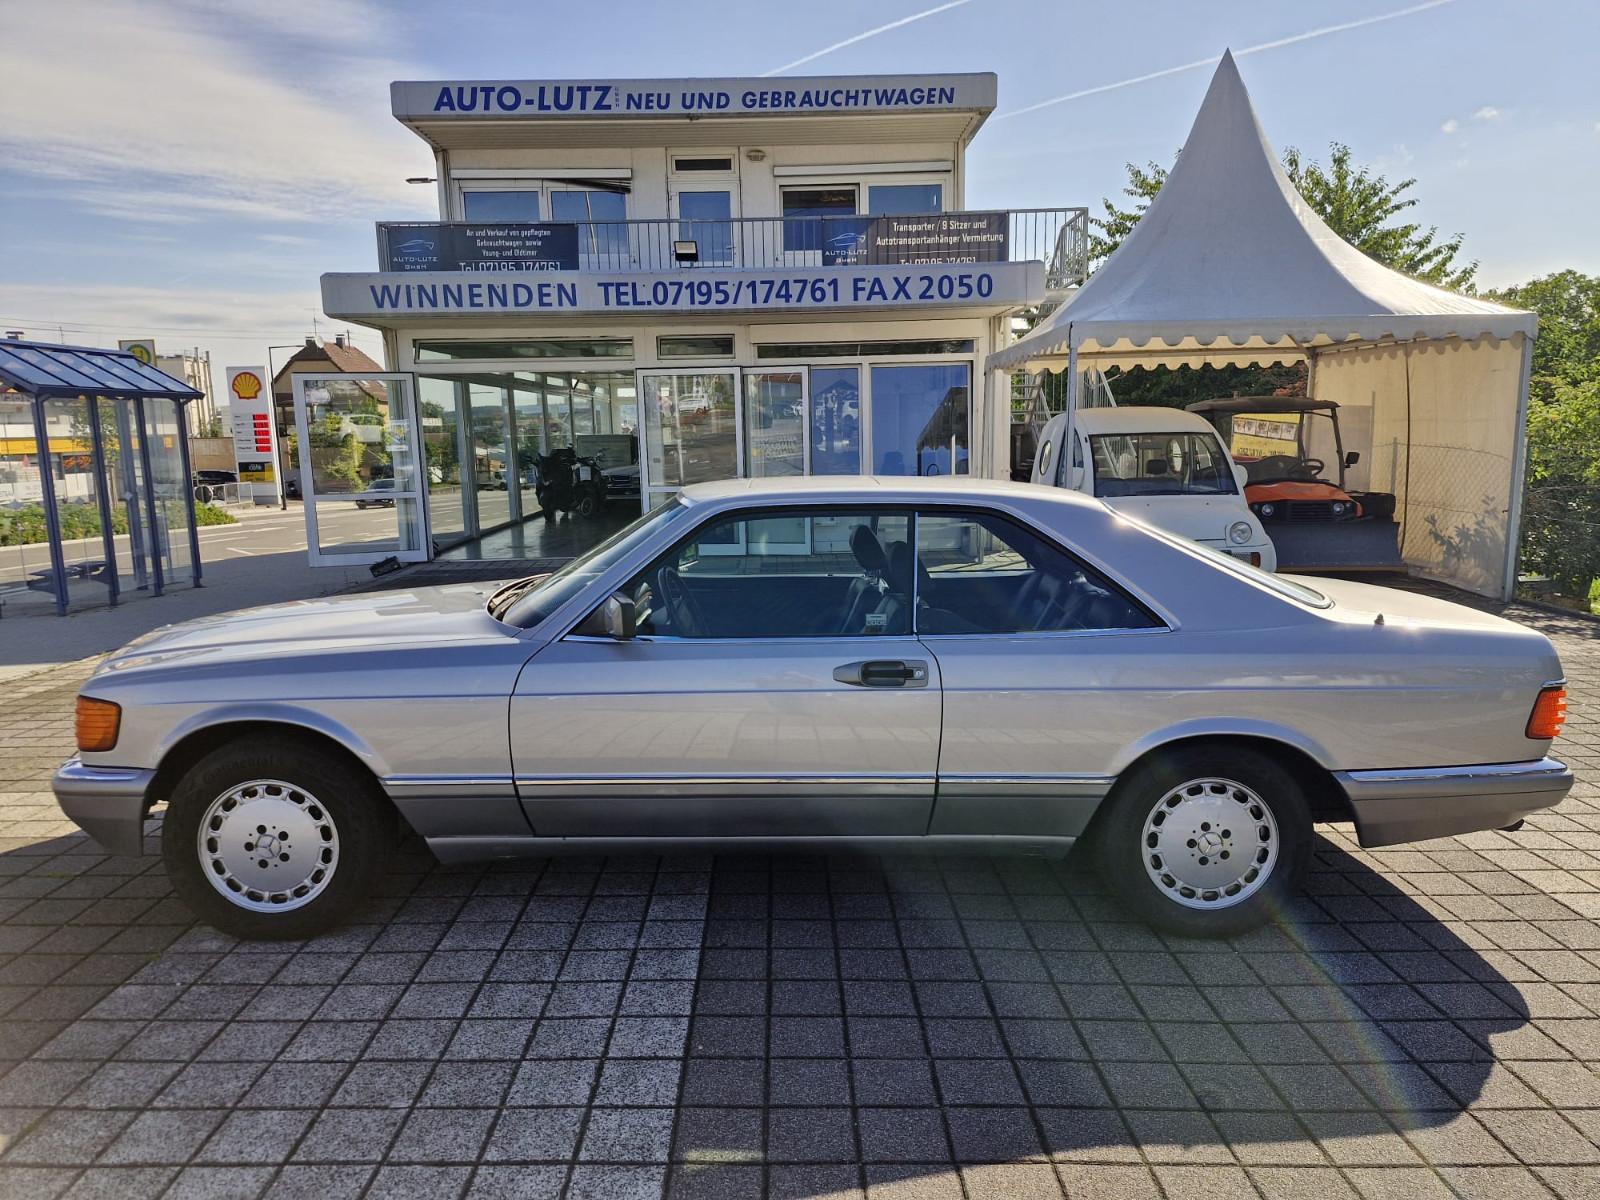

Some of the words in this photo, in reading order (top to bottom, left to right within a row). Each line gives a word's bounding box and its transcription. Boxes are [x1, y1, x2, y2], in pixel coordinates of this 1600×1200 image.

[433, 86, 612, 111] AUTO-LUTZ
[626, 93, 670, 110] NEU
[681, 92, 730, 110] UND
[741, 87, 955, 109] GEBRAUCHTWAGEN
[893, 222, 935, 232] Transporter
[950, 219, 971, 230] Sitzer
[973, 219, 987, 229] und
[521, 229, 551, 237] gepflegten
[476, 239, 523, 247] Gebrauchtwagen
[876, 234, 961, 247] Autotransportanhänger
[962, 233, 1004, 244] Vermietung
[370, 283, 577, 308] WINNENDEN
[597, 277, 839, 306] TEL.07195/174761
[853, 276, 912, 302] FAX
[918, 273, 993, 299] 2050
